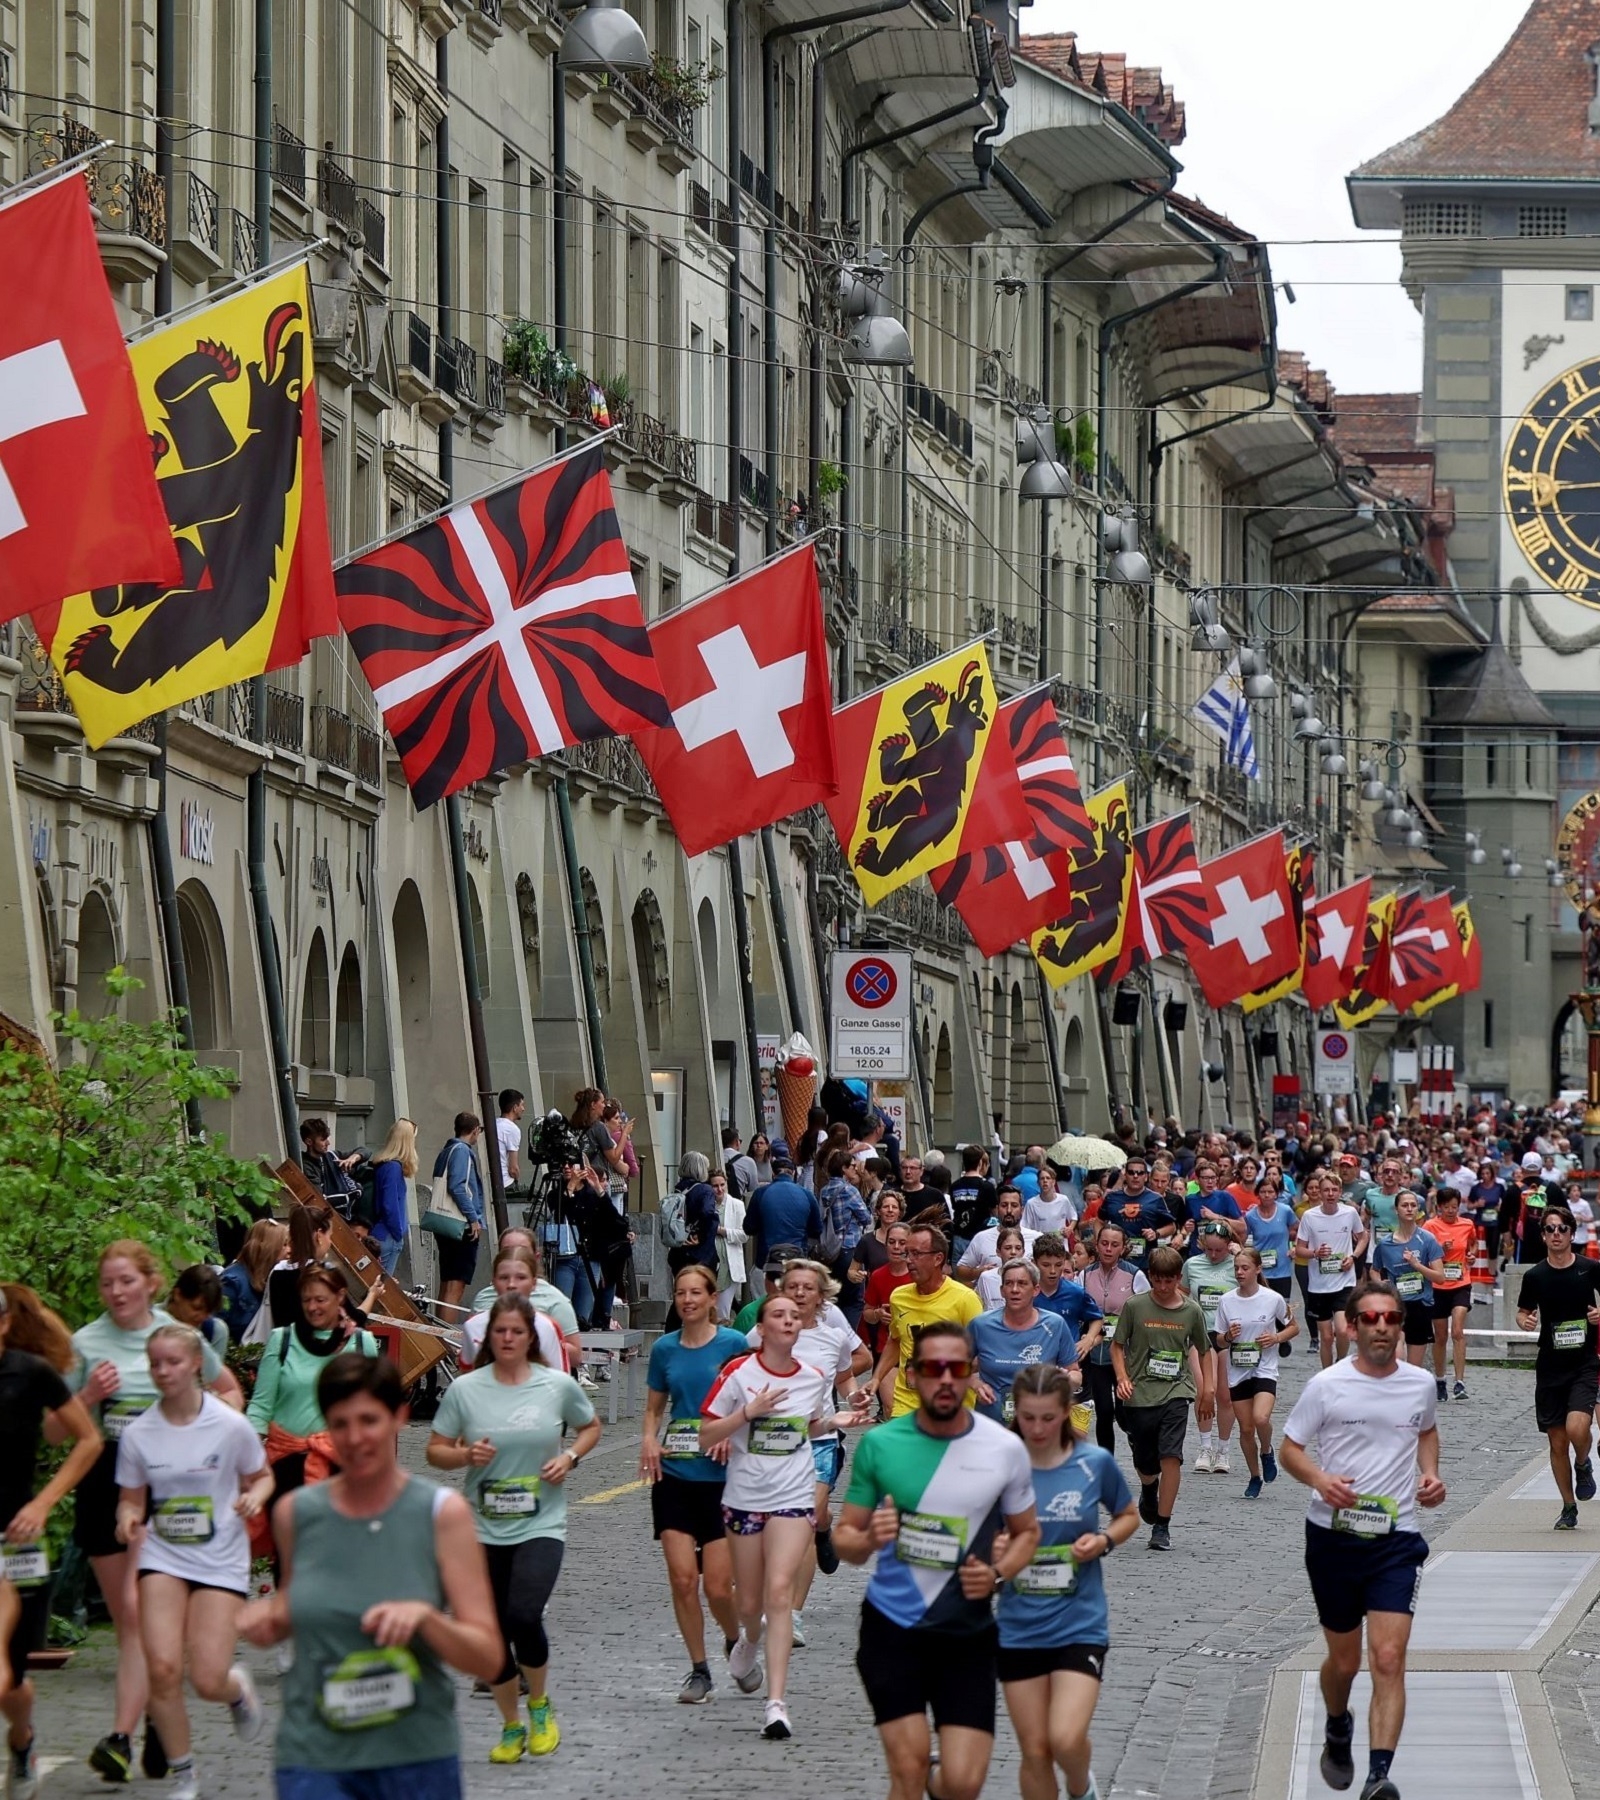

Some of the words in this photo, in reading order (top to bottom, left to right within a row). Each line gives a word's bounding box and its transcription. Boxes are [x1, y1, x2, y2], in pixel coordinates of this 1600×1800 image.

[1562, 372, 1589, 401] XI
[1523, 414, 1546, 438] X
[188, 799, 214, 867] kiosk
[840, 1019, 869, 1028] Ganze
[871, 1019, 901, 1028] Gasse
[850, 1046, 891, 1055] 18.05.24
[856, 1059, 883, 1068] 12.00
[1557, 1331, 1582, 1339] Maxime
[766, 1432, 789, 1441] Sofia
[1343, 1510, 1387, 1525] Raphael
[1029, 1566, 1056, 1577] Nina
